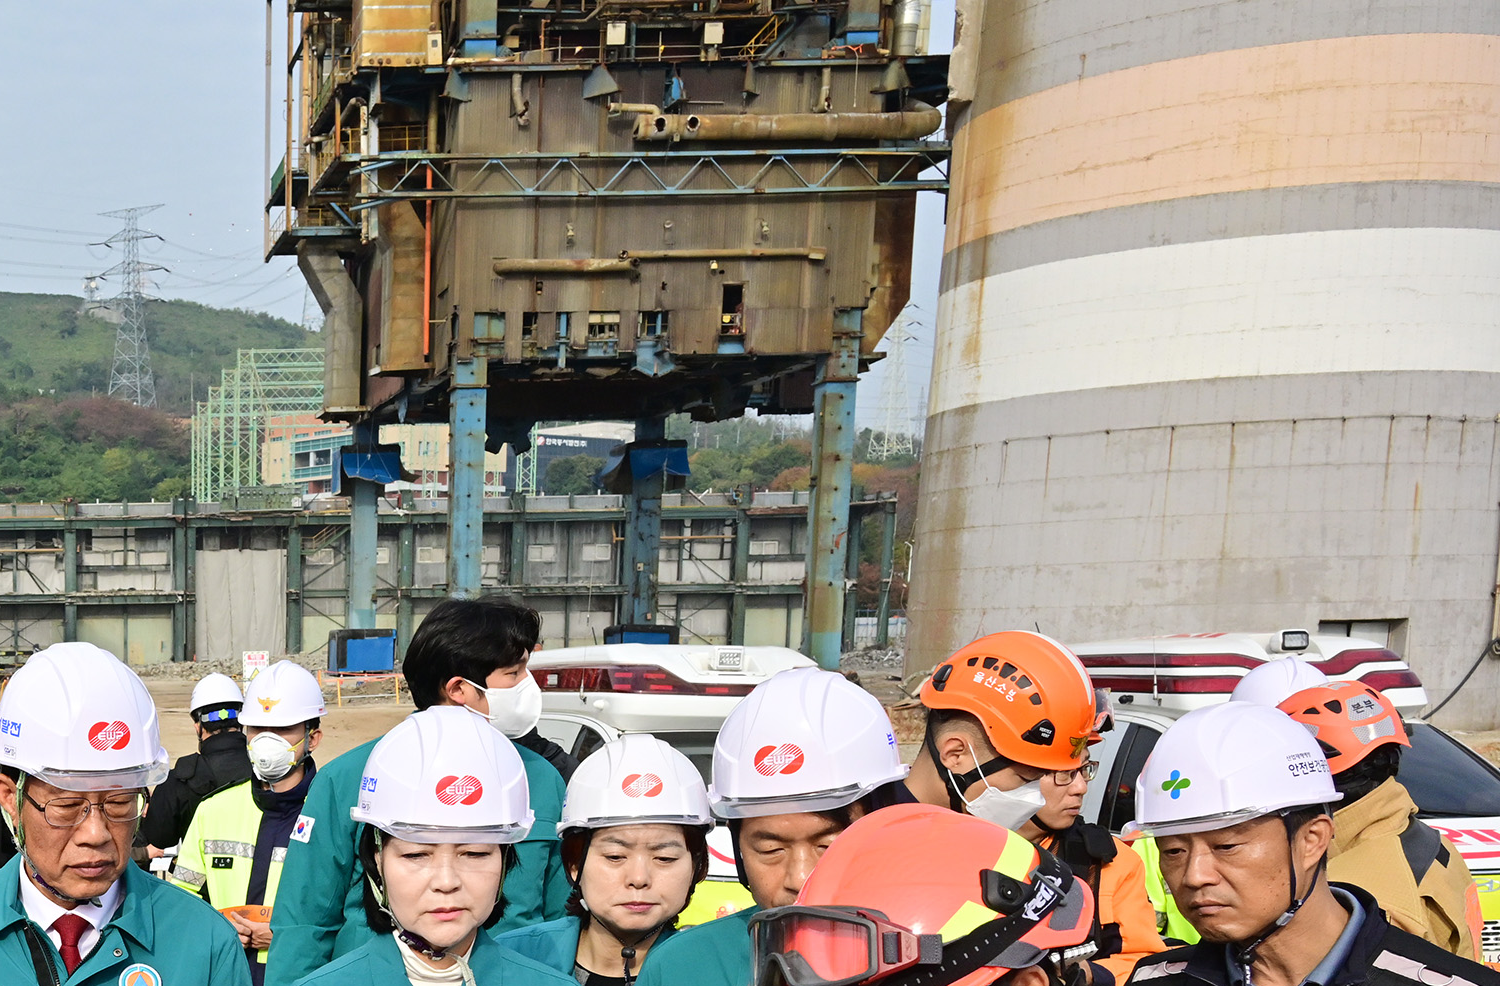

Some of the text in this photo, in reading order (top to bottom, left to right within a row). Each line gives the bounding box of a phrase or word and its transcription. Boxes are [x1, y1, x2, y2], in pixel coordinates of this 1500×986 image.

[973, 671, 1017, 702] 울산소방
[1351, 699, 1375, 714] 본부
[97, 731, 124, 741] EWP
[763, 754, 796, 766] EWP
[445, 785, 476, 795] EWP
